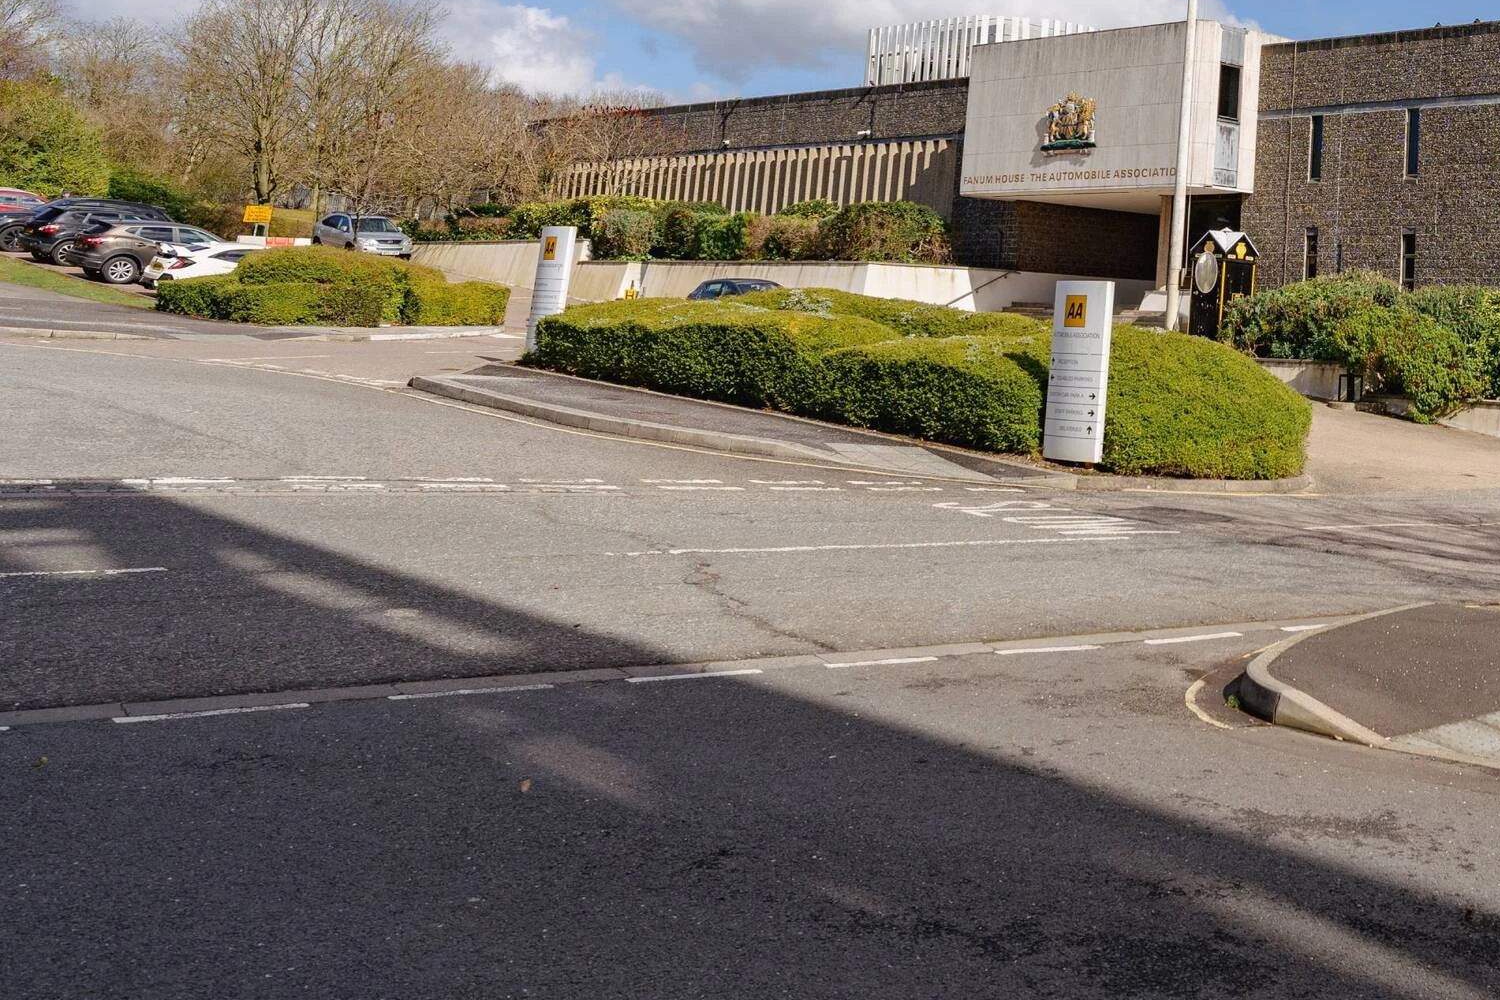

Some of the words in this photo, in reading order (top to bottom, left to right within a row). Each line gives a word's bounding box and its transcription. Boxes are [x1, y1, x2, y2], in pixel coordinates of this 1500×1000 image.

[963, 176, 993, 185] FANUM
[995, 174, 1025, 184] HOUSE
[1030, 172, 1047, 182] THE
[1049, 169, 1111, 181] AUTOMOBILE
[1113, 167, 1177, 179] ASSOCIATIO
[1067, 302, 1083, 319] AA
